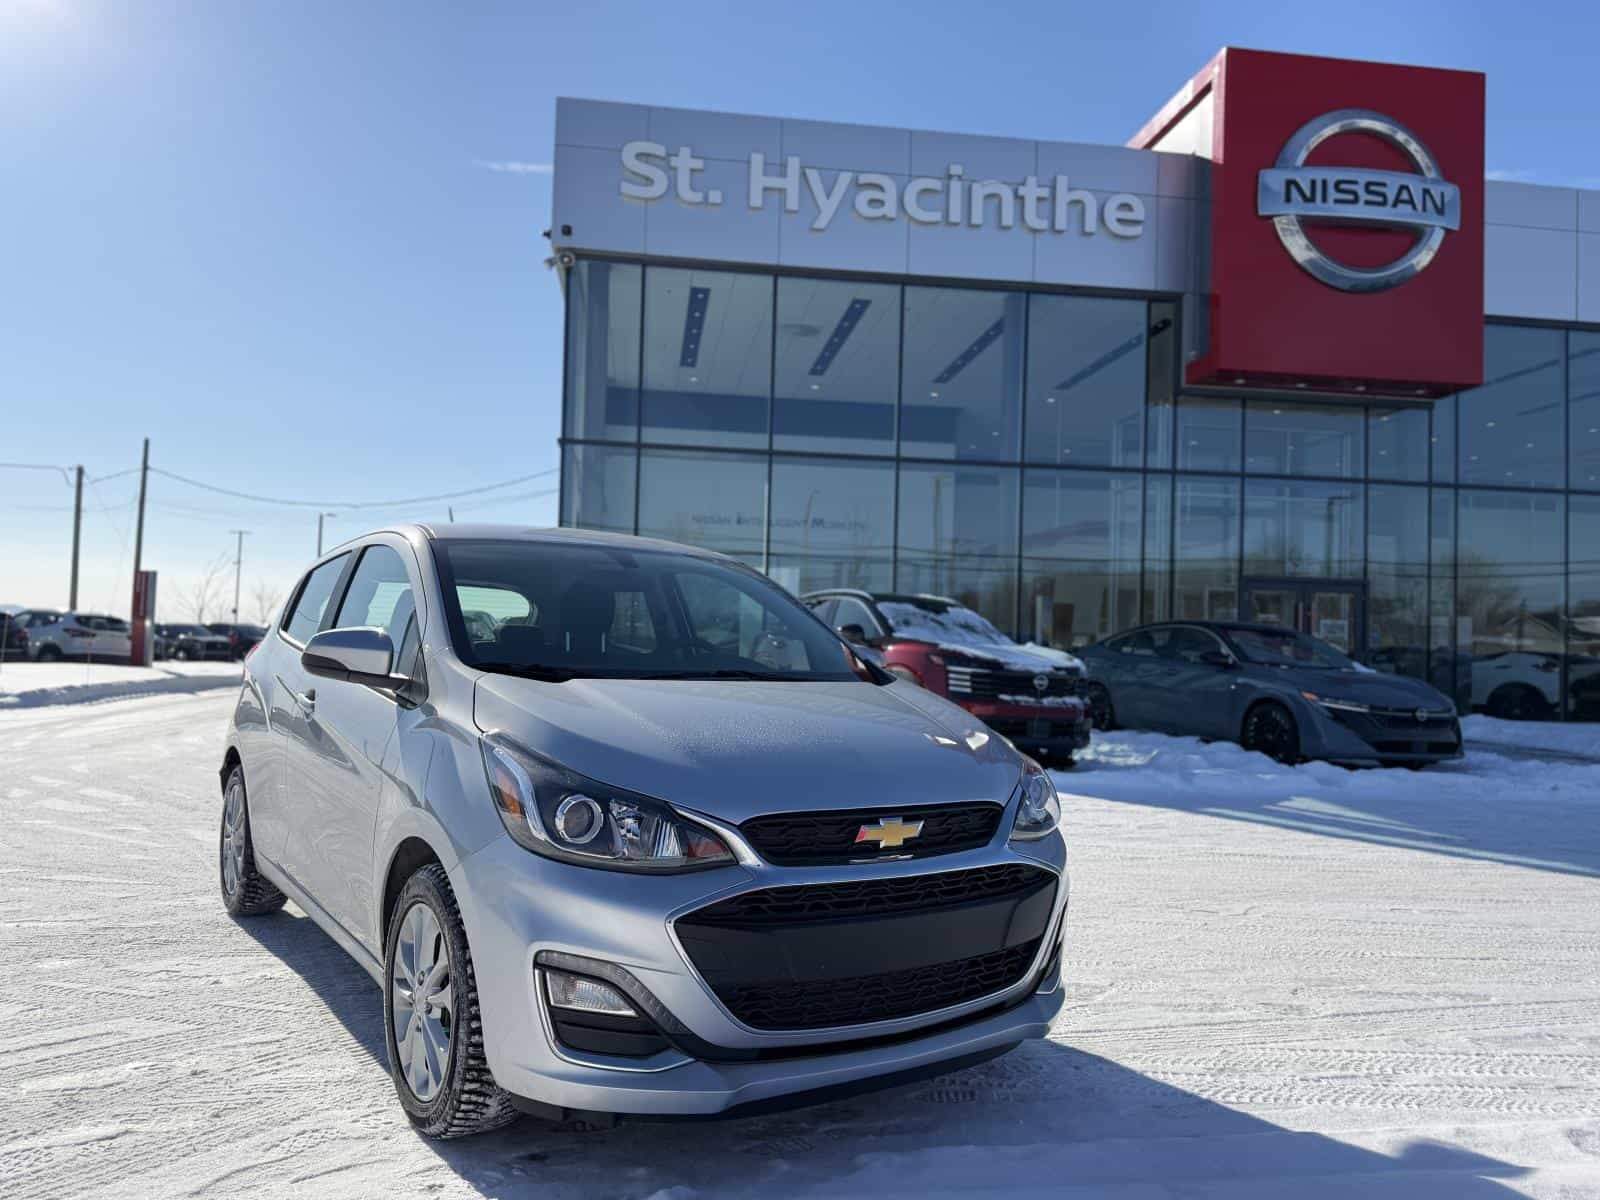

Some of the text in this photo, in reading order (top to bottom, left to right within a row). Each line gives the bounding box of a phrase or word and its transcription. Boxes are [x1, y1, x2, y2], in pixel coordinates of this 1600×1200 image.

[619, 140, 1146, 239] St. Hyacinthe
[1284, 178, 1446, 217] NISSAN
